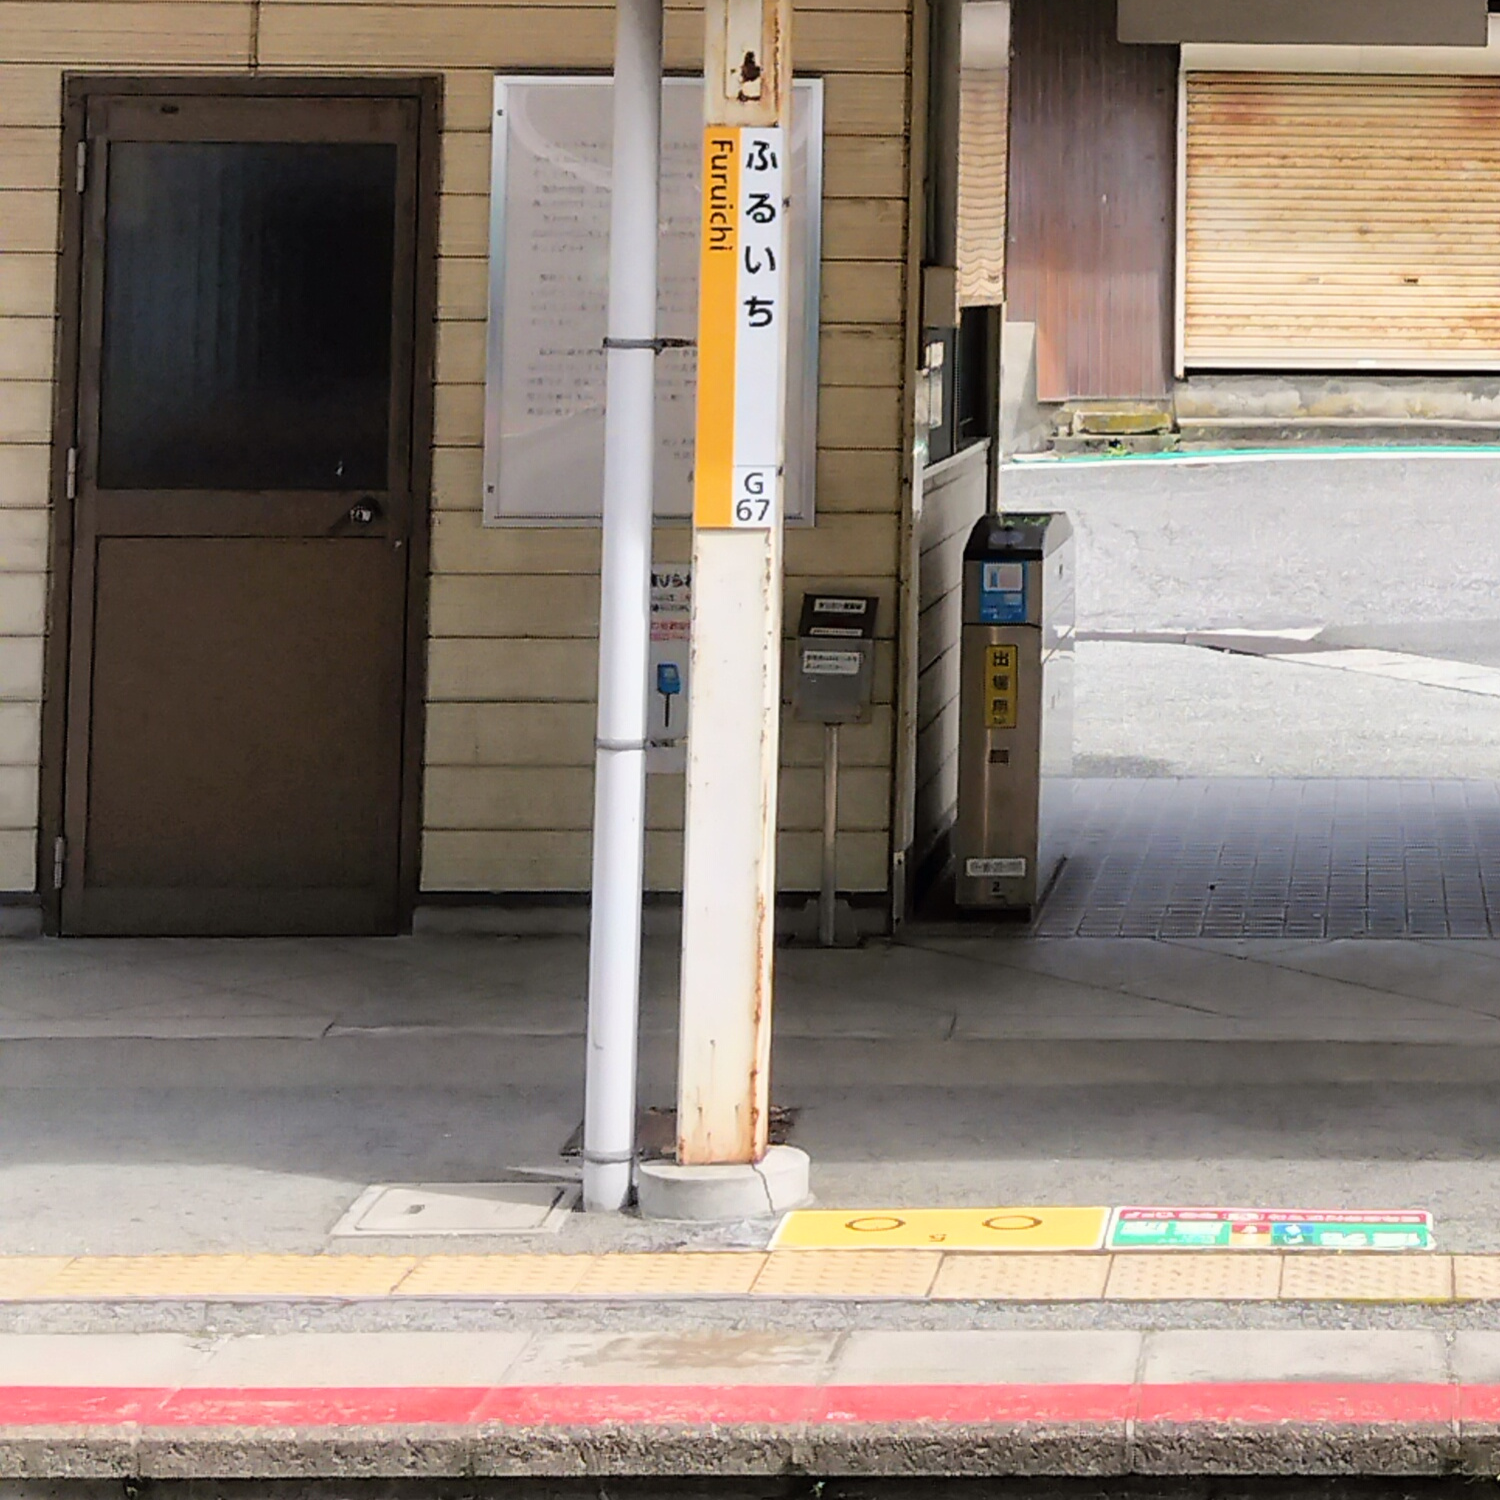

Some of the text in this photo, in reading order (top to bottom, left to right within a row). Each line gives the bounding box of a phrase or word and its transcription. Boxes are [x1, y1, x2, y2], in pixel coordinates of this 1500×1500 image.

[709, 139, 733, 251] Furuichi
[743, 140, 778, 328] ふるいち
[735, 498, 770, 522] 67
[743, 471, 764, 496] G
